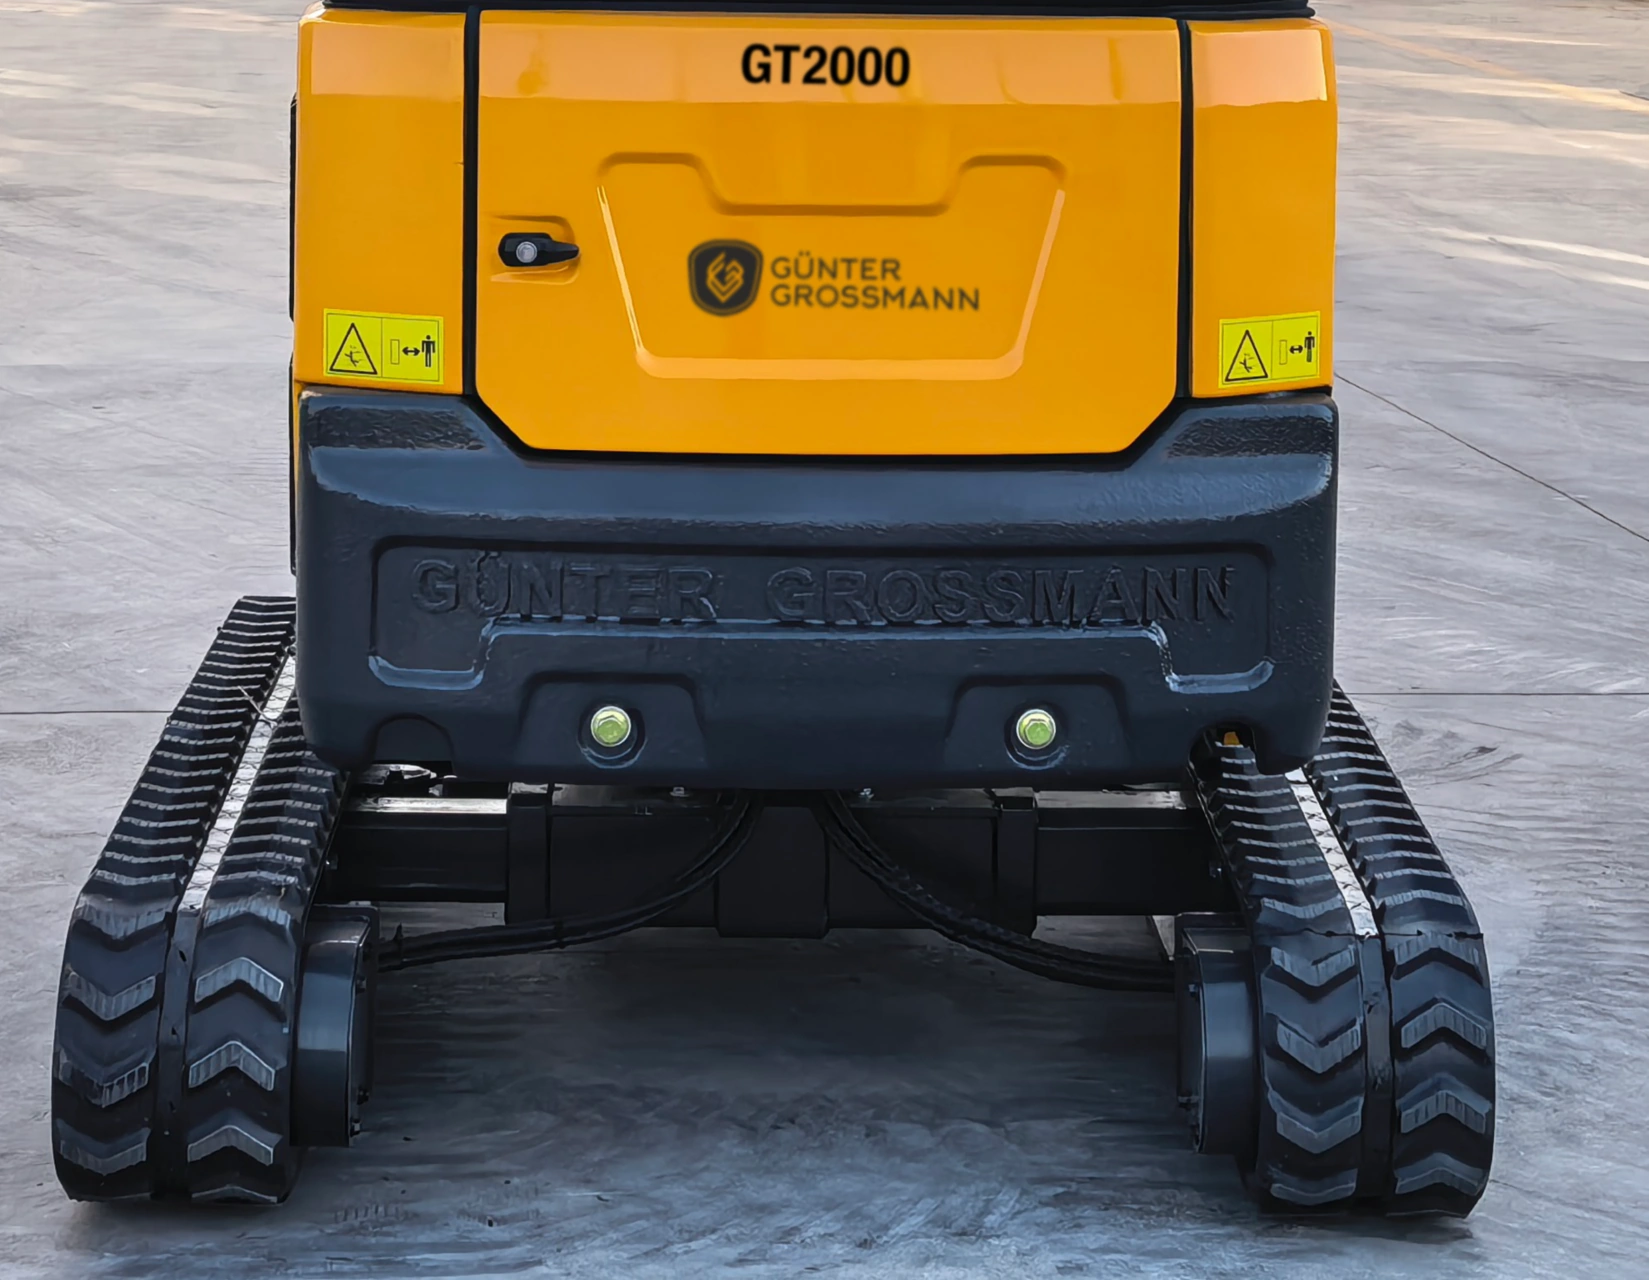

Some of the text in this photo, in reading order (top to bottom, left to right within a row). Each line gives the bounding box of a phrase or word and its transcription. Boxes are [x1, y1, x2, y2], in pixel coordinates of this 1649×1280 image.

[741, 43, 911, 87] GT2000
[770, 250, 901, 281] GÜNTER
[770, 284, 980, 311] GROSSMANN
[766, 565, 1237, 624] GROSSMANN
